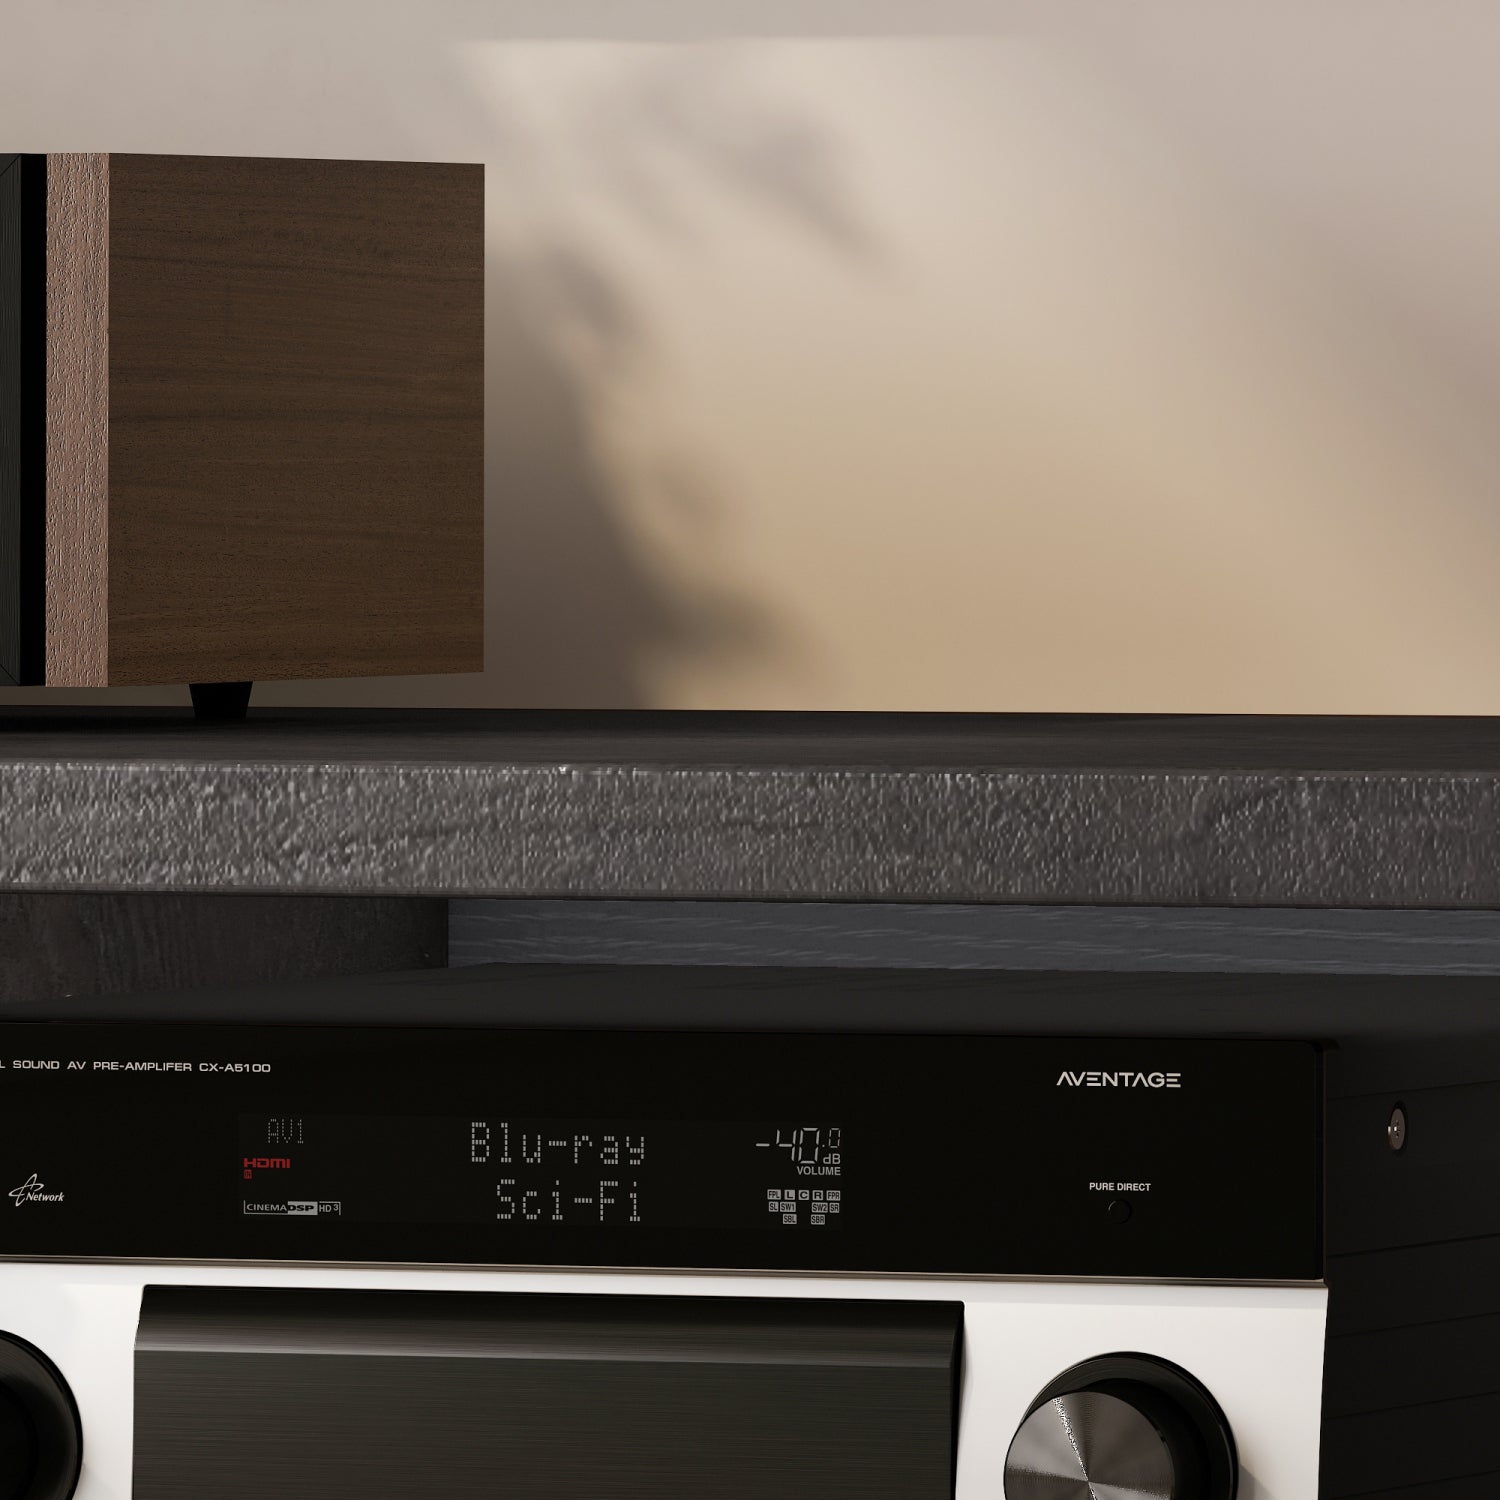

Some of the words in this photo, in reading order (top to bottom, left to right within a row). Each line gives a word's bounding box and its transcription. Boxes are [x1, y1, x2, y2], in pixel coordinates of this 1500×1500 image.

[12, 1060, 60, 1070] SOUND
[67, 1061, 87, 1070] AV
[93, 1061, 193, 1072] PRE-AMPLIFER
[199, 1062, 271, 1073] CX-A5100
[1056, 1071, 1182, 1088] AVENTAGE
[267, 1118, 304, 1144] AV1
[471, 1121, 645, 1166] Blu-ray
[243, 1157, 291, 1169] HDMI
[822, 1153, 841, 1165] dB
[796, 1165, 842, 1176] VOLUME
[1089, 1182, 1115, 1191] PURE
[1116, 1182, 1152, 1192] DIRECT
[25, 1191, 65, 1202] Network
[496, 1178, 641, 1222] Sci-Fi
[768, 1190, 780, 1199] FPL
[781, 1202, 796, 1212] SW1
[812, 1203, 827, 1212] SW2
